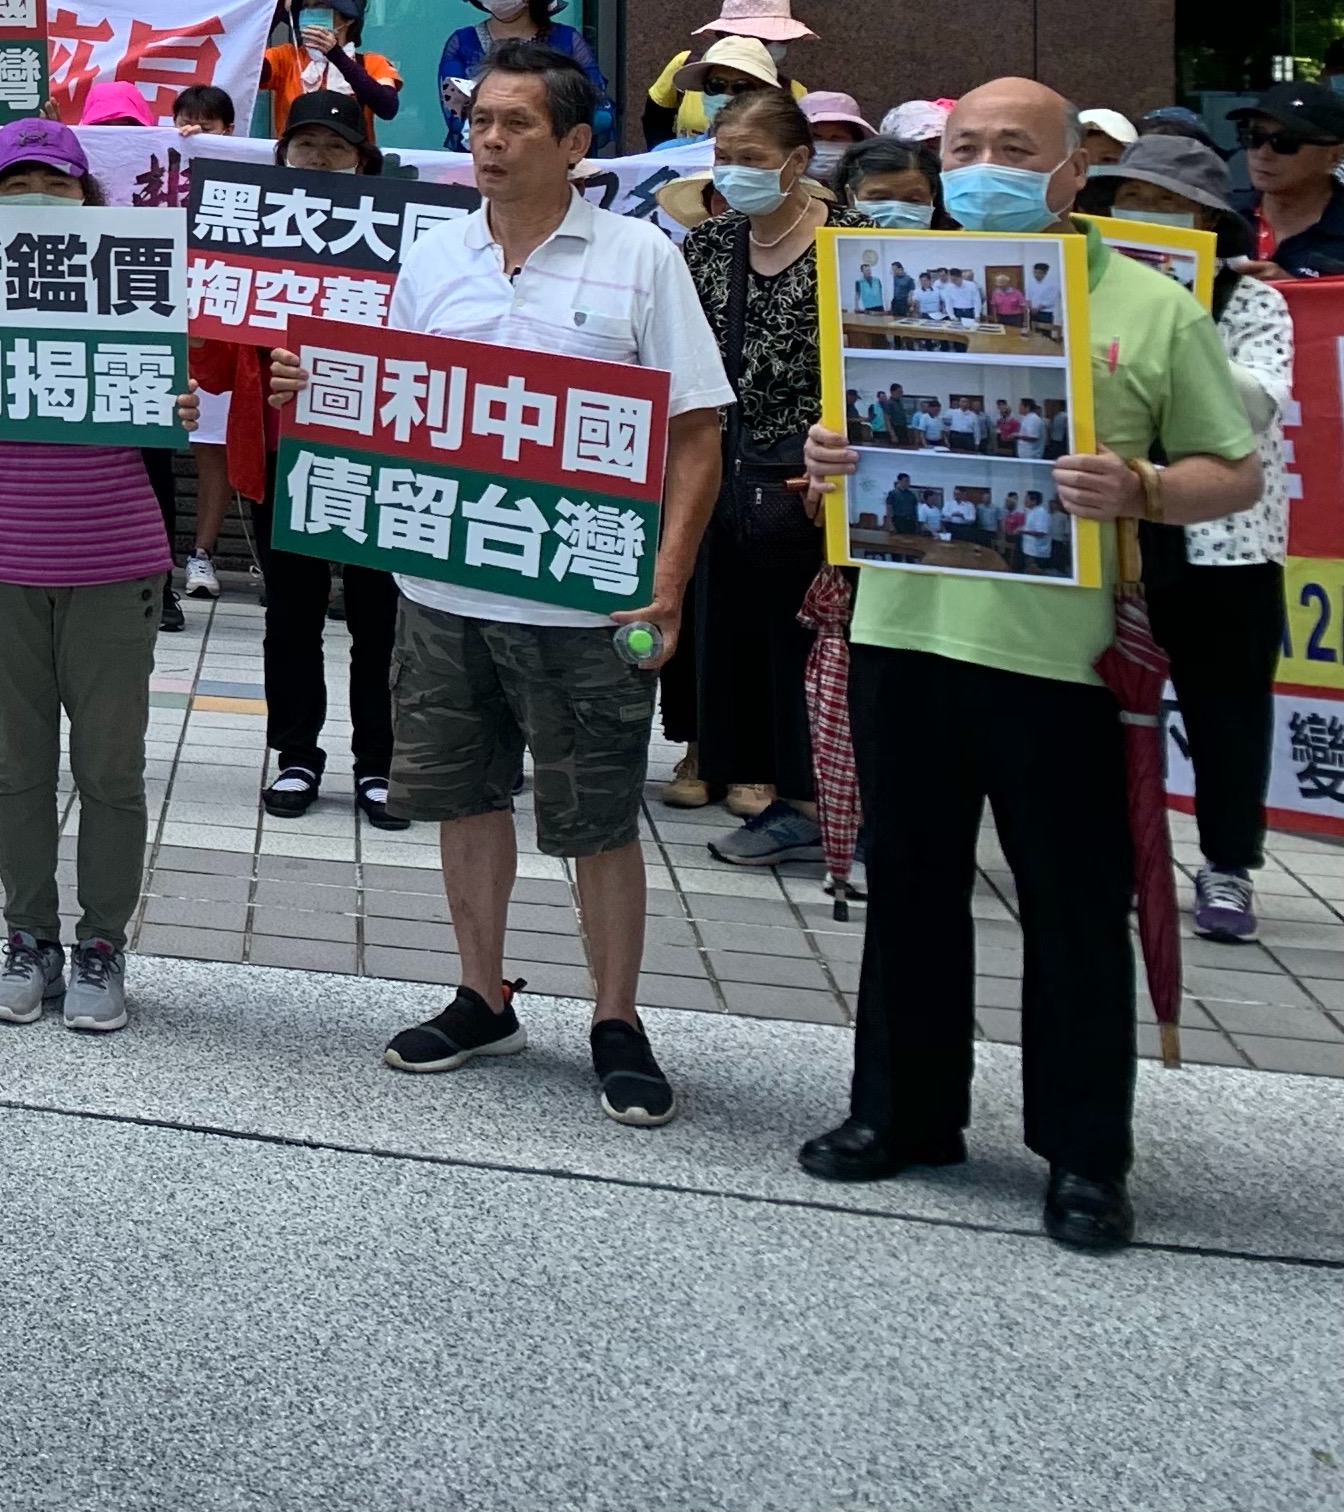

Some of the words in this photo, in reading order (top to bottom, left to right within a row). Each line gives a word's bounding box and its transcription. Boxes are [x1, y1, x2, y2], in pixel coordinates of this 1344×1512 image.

[294, 345, 653, 484] 圖利中國
[287, 450, 646, 596] 債留台灣
